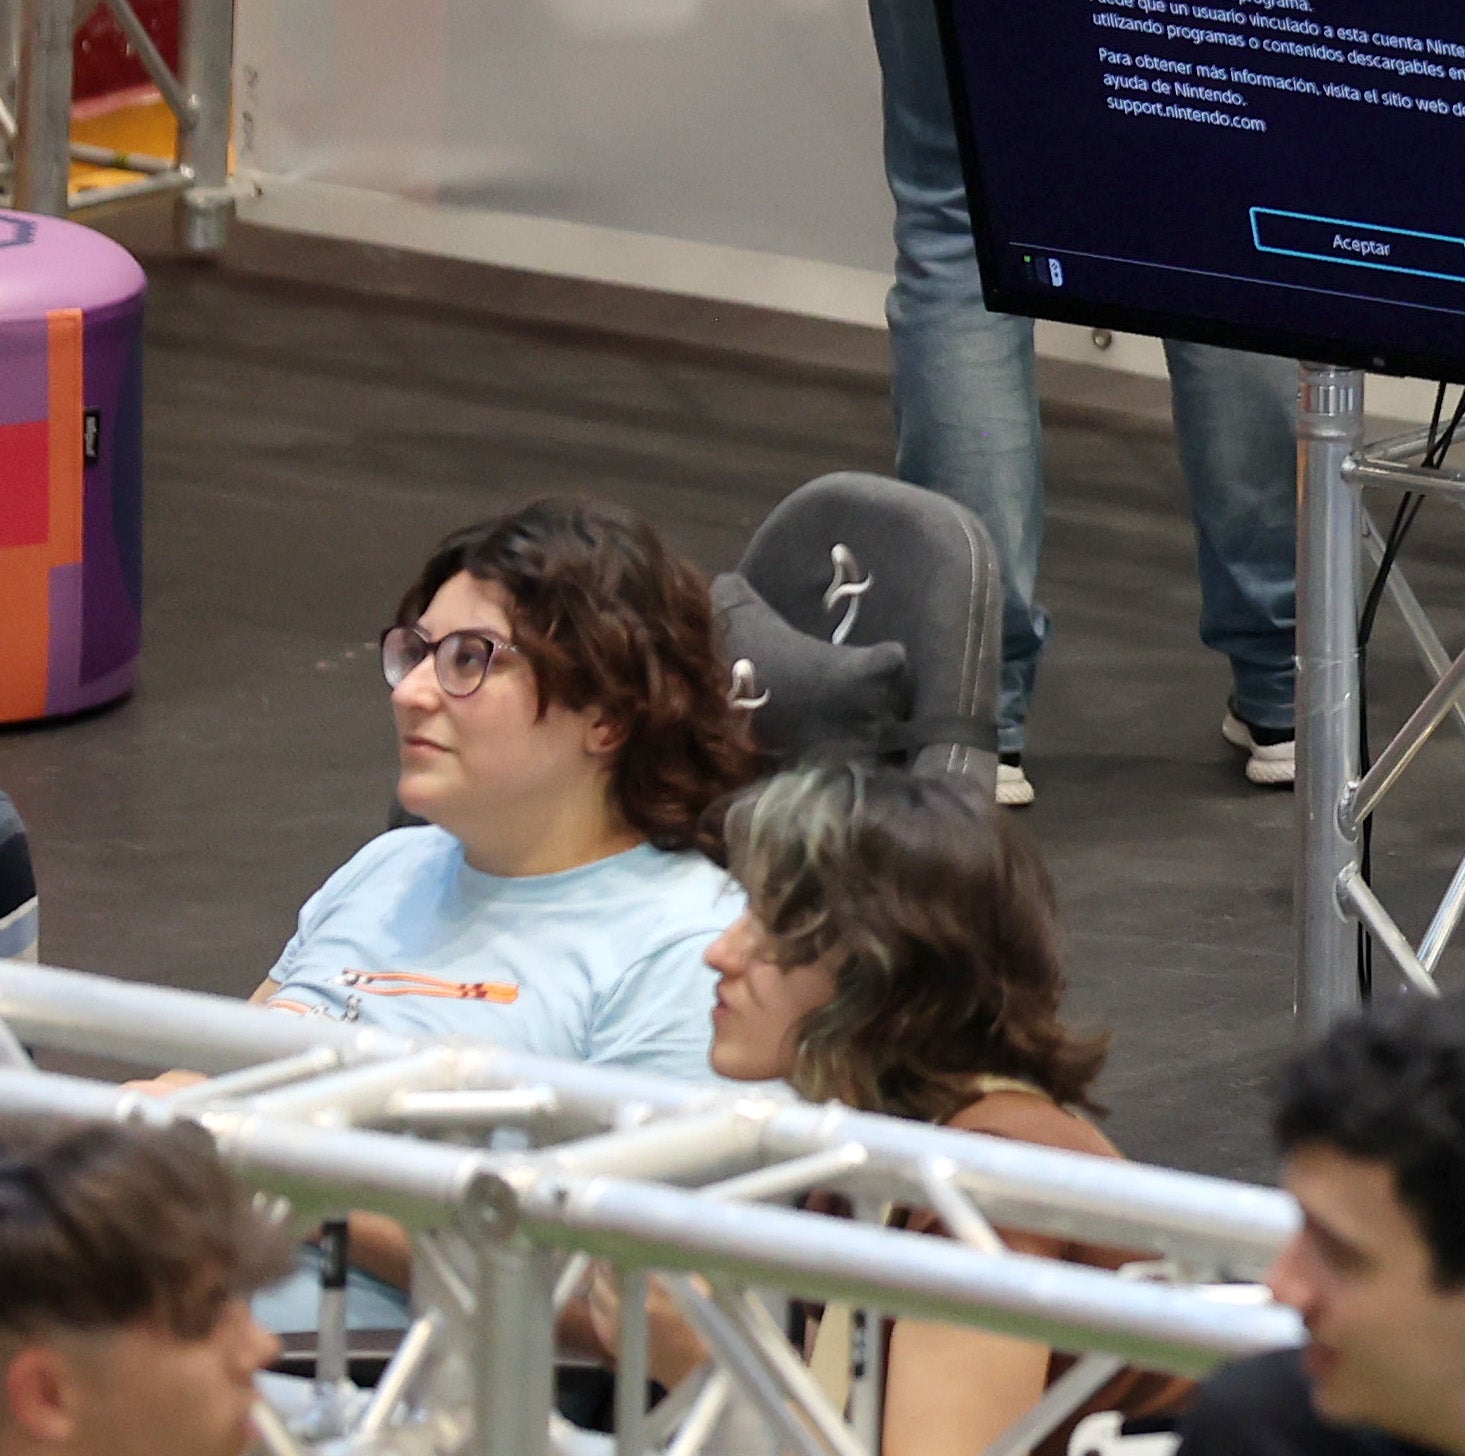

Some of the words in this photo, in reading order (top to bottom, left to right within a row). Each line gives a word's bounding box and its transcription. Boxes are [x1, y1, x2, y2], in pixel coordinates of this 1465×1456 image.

[1092, 13, 1163, 34] utilizando
[1166, 25, 1245, 46] programas
[1248, 37, 1259, 49] o
[1262, 40, 1344, 62] contenidos
[1347, 51, 1445, 77] descargables
[1170, 3, 1189, 16] un
[1192, 7, 1246, 24] usuario
[1248, 14, 1320, 35] vinculado
[1324, 25, 1333, 38] a
[1336, 28, 1368, 43] esta
[1372, 33, 1424, 51] cuenta
[1098, 48, 1132, 65] Para
[1135, 55, 1191, 74] obtener
[1196, 65, 1227, 80] más
[1230, 69, 1320, 94] información,
[1322, 83, 1360, 100] visita
[1364, 89, 1378, 104] el
[1381, 92, 1412, 108] sitio
[1415, 99, 1449, 114] web
[1103, 74, 1148, 91] ayuda
[1151, 79, 1171, 94] de
[1174, 82, 1246, 105] Nintendo.
[1107, 98, 1265, 130] support.nintendo.com
[1332, 234, 1391, 256] Aceptar
